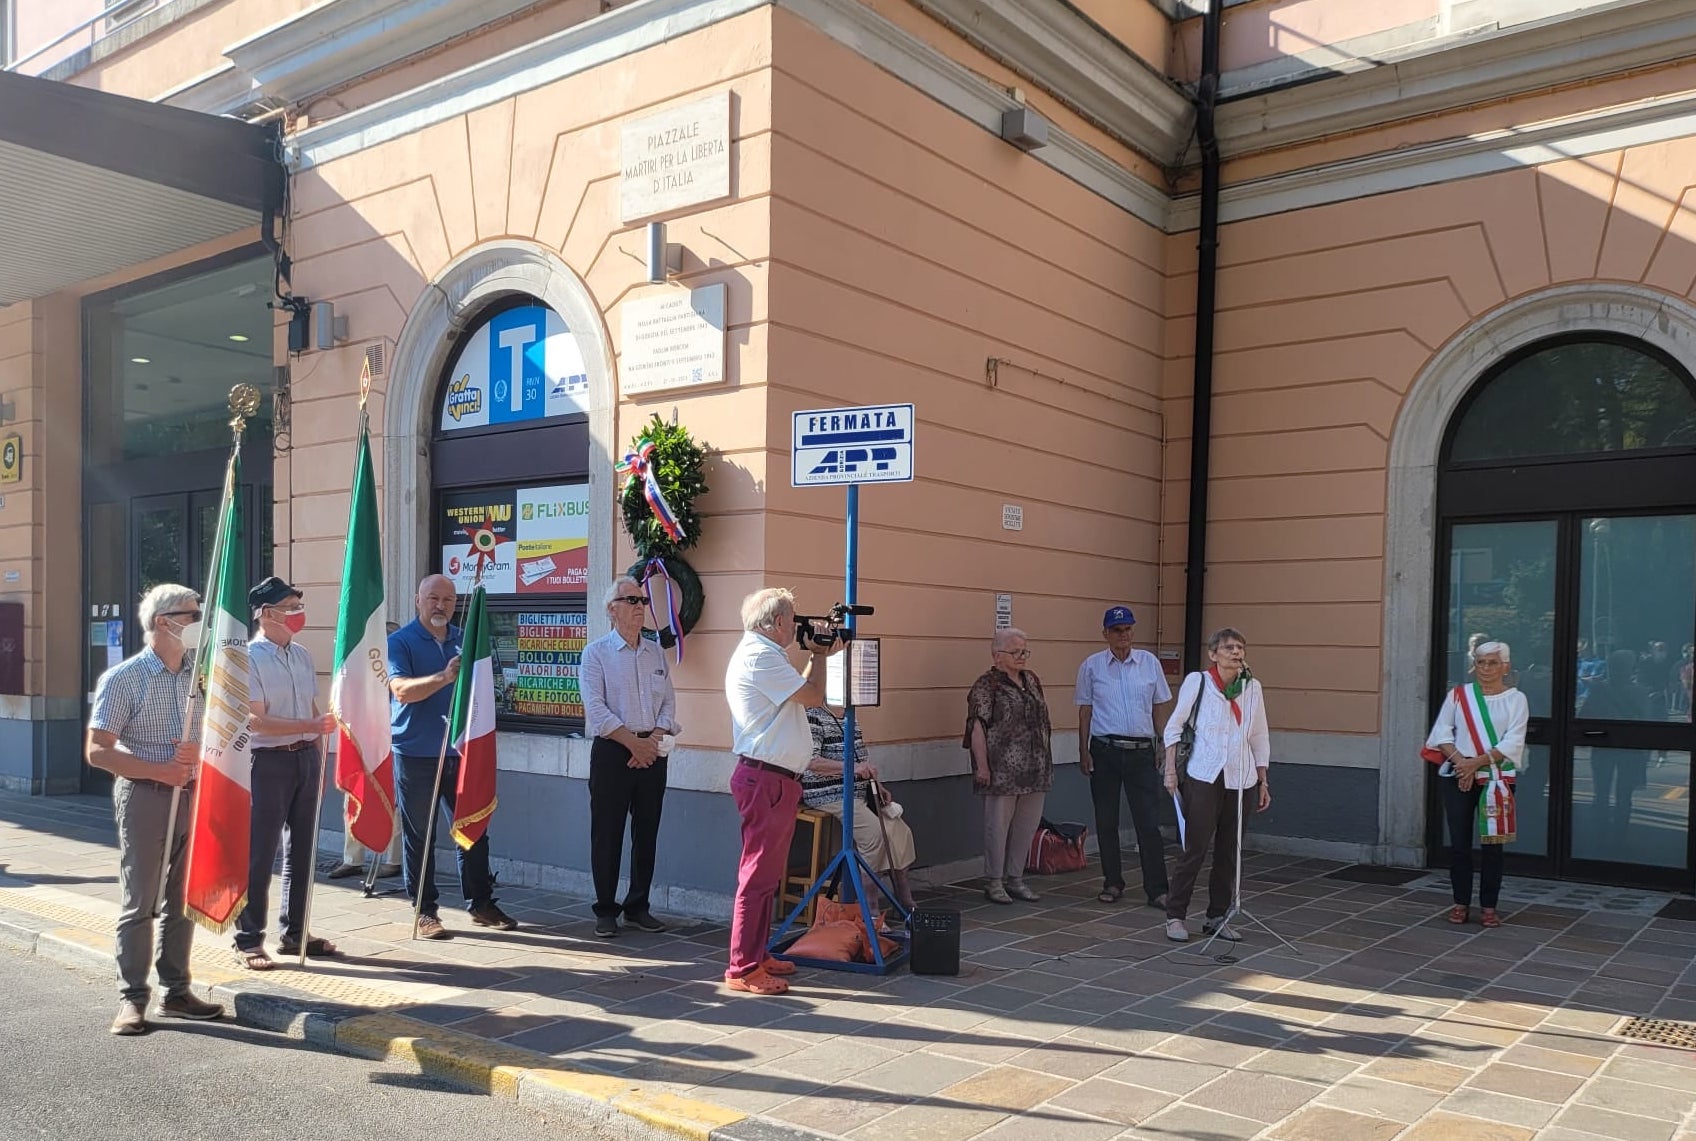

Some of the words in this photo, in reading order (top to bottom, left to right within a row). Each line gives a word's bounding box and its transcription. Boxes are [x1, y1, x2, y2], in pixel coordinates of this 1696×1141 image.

[647, 121, 699, 151] PIAZZALE
[625, 158, 657, 181] MARTIRI
[660, 153, 674, 171] PER
[677, 151, 688, 165] LA
[653, 170, 694, 194] D'ITALIA
[499, 324, 536, 412] T
[449, 389, 477, 404] Gratta
[526, 388, 537, 401] 30
[809, 411, 897, 433] FERMATA
[447, 506, 485, 517] WESTERN
[458, 514, 485, 524] UNION
[567, 568, 583, 576] PAGA
[520, 614, 557, 625] BIGLIETTI
[559, 614, 587, 625] AUTOB
[519, 626, 564, 638] BIGLIETTI
[570, 627, 587, 638] TRE
[519, 639, 557, 650] RICARICHE
[519, 651, 554, 664] BOLLO
[557, 652, 581, 664] AUT
[519, 665, 553, 676] VALORI
[518, 677, 564, 690] RICARICHE
[518, 690, 536, 701] FAX
[537, 691, 542, 702] E
[545, 691, 582, 703] FOTOCO
[518, 702, 560, 715] PAGAMENTO
[561, 704, 583, 717] BOLLE
